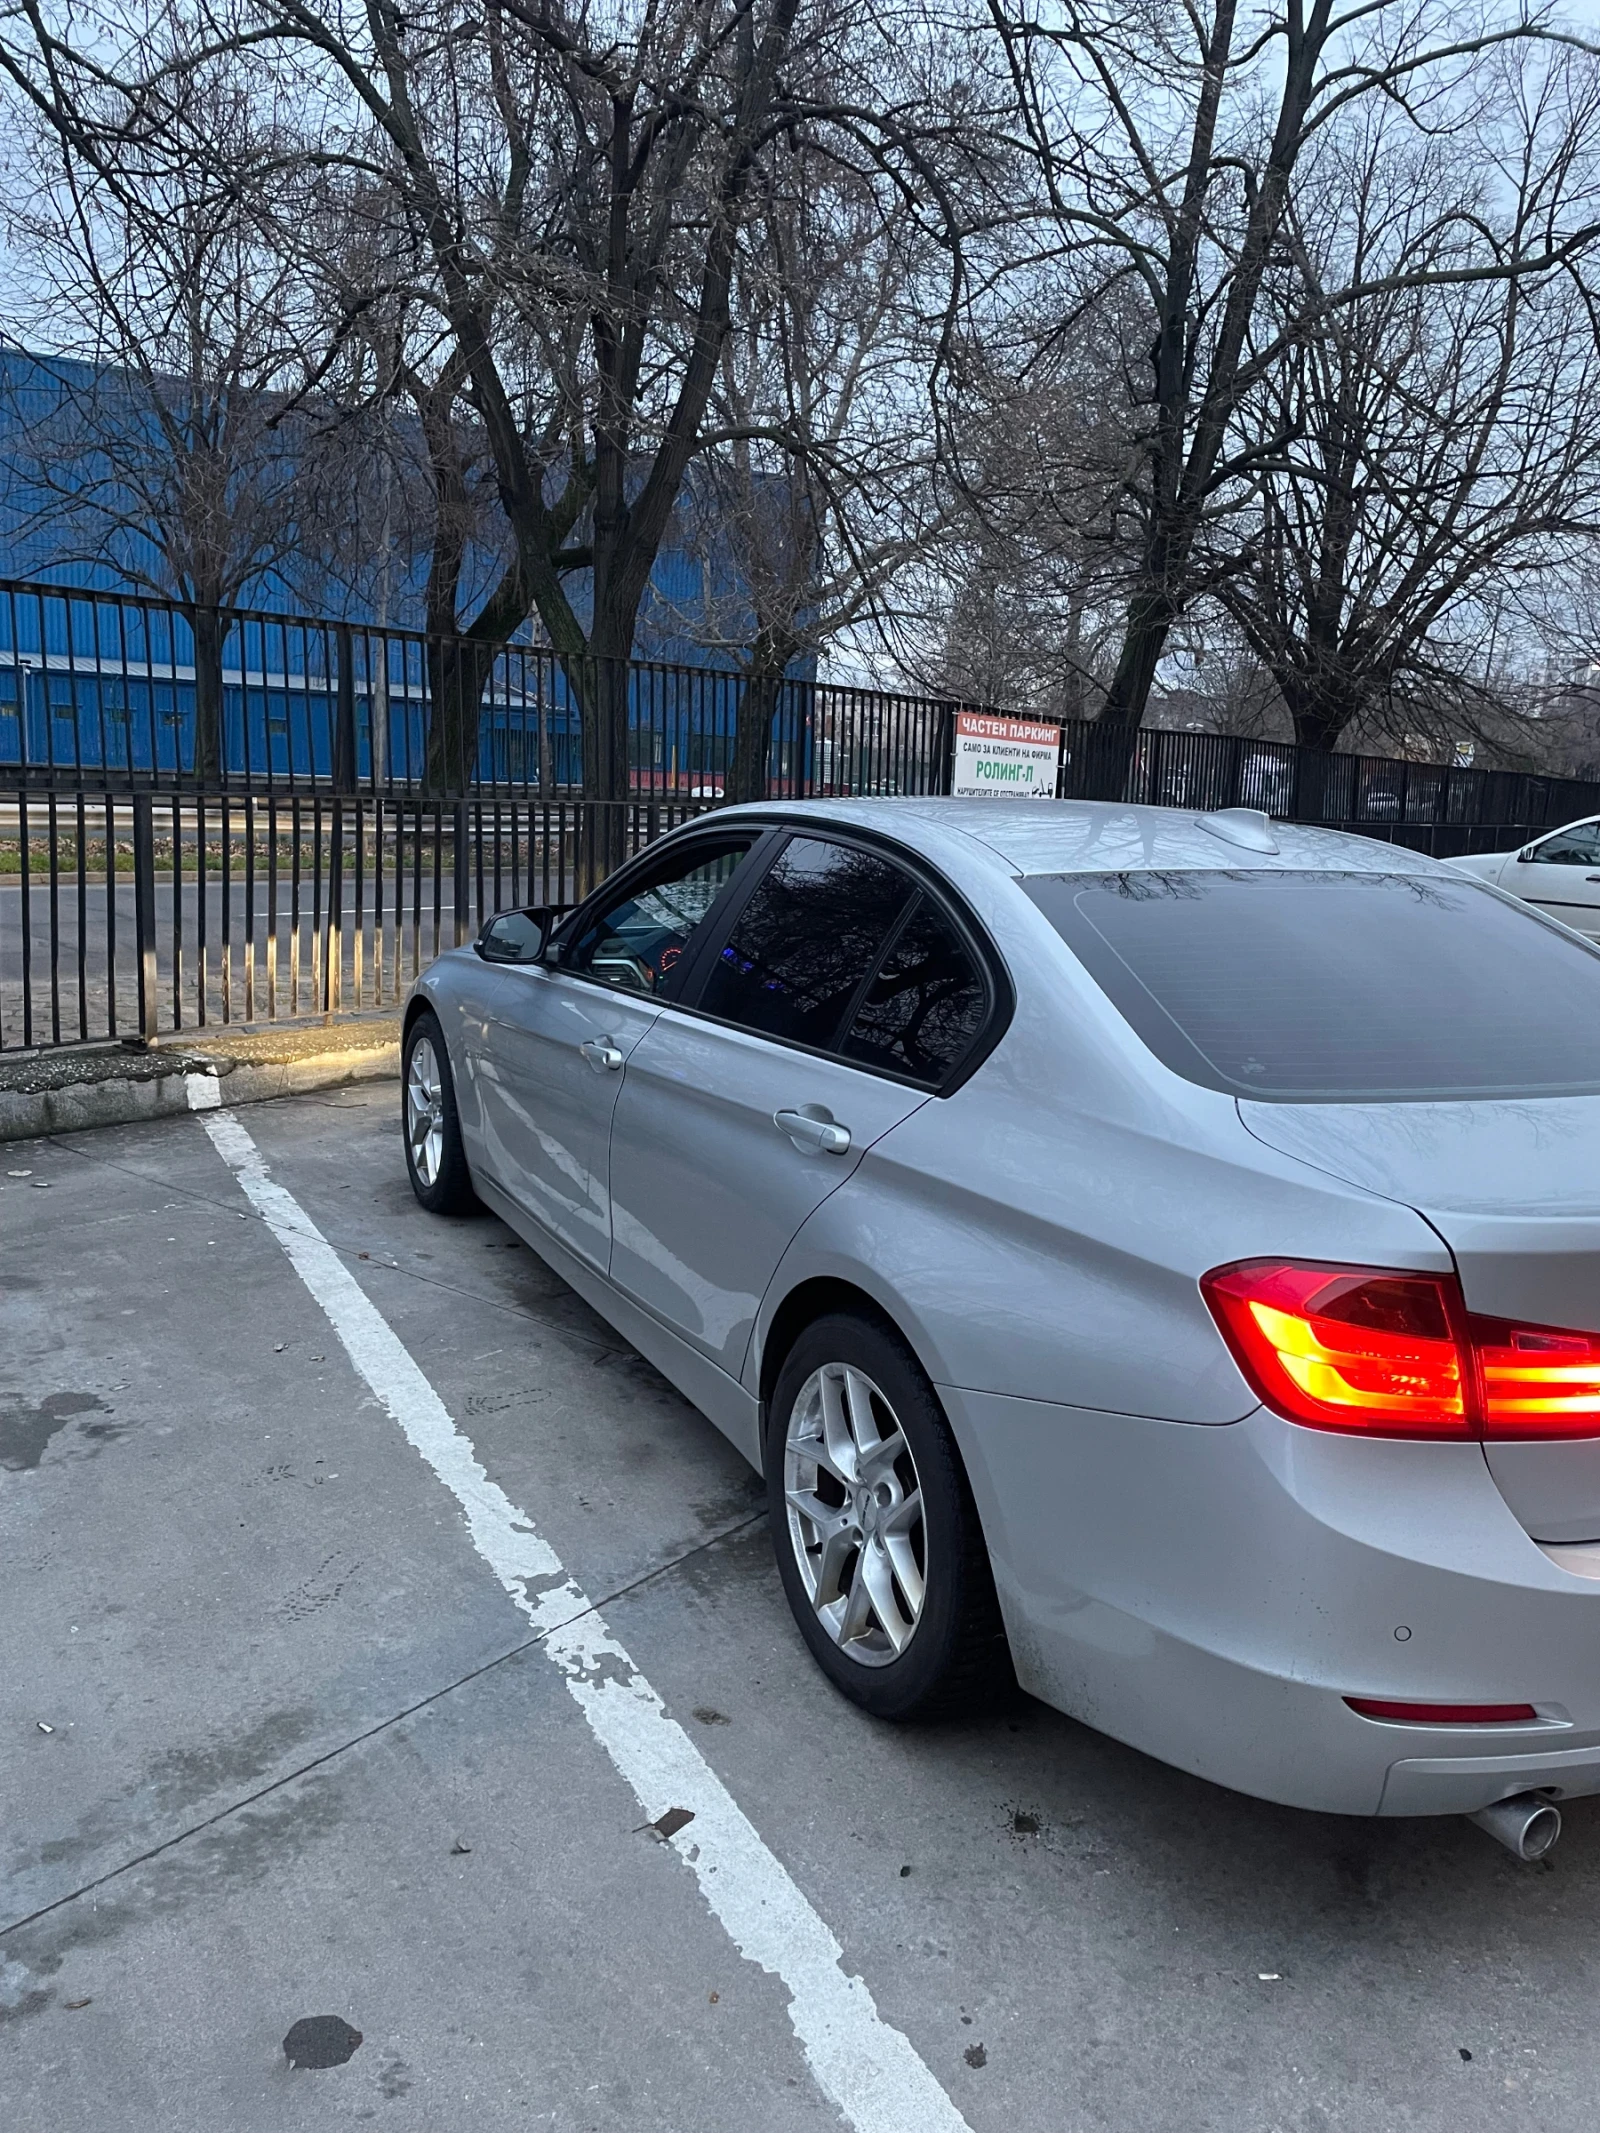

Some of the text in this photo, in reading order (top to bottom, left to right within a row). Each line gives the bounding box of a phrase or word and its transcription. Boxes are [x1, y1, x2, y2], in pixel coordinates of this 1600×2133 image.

[962, 717, 1057, 742] ЧАСТЕН ПАРКИНГ
[963, 742, 1052, 760] САМО ЗА КЛИЕНТИ НА ФИРМА
[976, 760, 1034, 782] РОЛИНГ-Л
